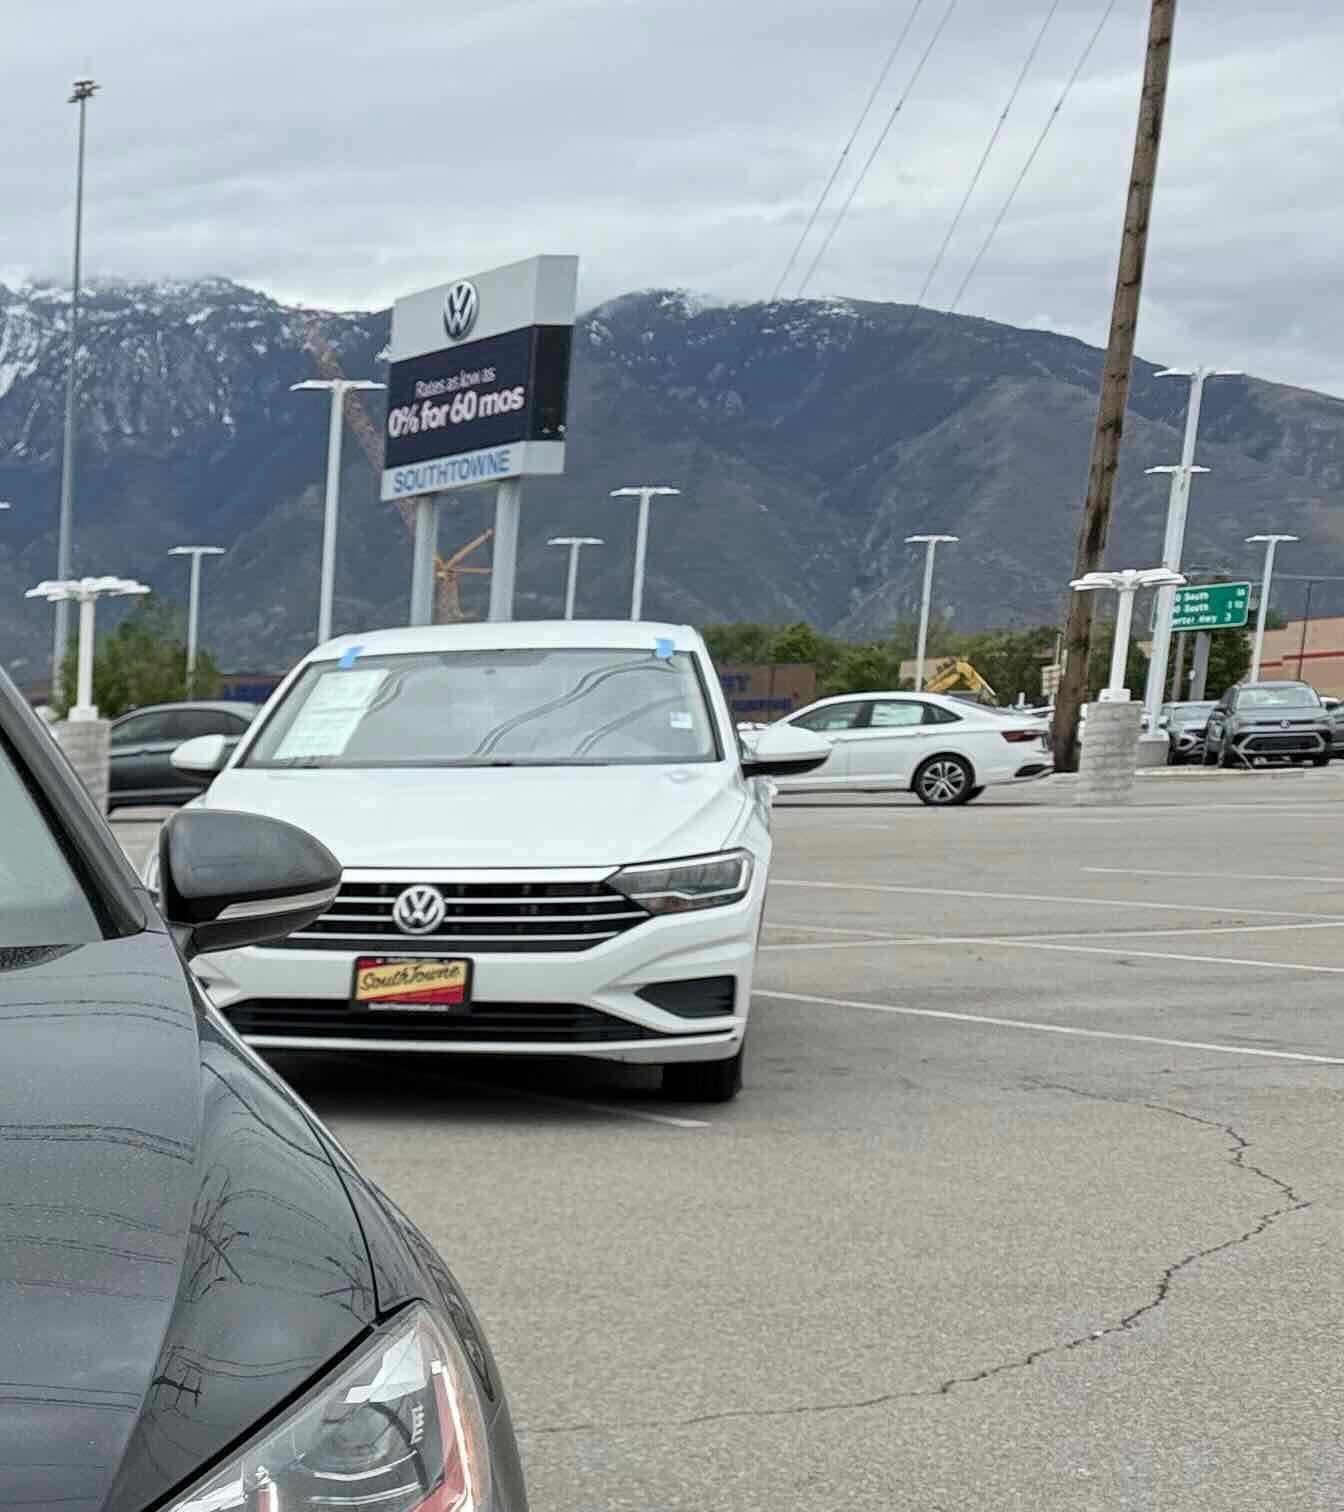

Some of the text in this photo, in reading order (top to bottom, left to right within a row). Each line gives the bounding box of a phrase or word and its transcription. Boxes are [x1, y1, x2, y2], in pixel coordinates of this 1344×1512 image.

[444, 280, 478, 341] VW
[415, 381, 445, 397] Rates
[446, 377, 458, 390] as
[460, 369, 480, 387] low
[388, 386, 525, 438] 0% for 60 mos
[393, 449, 511, 494] SOUTHTOWNE
[393, 885, 446, 934] VW
